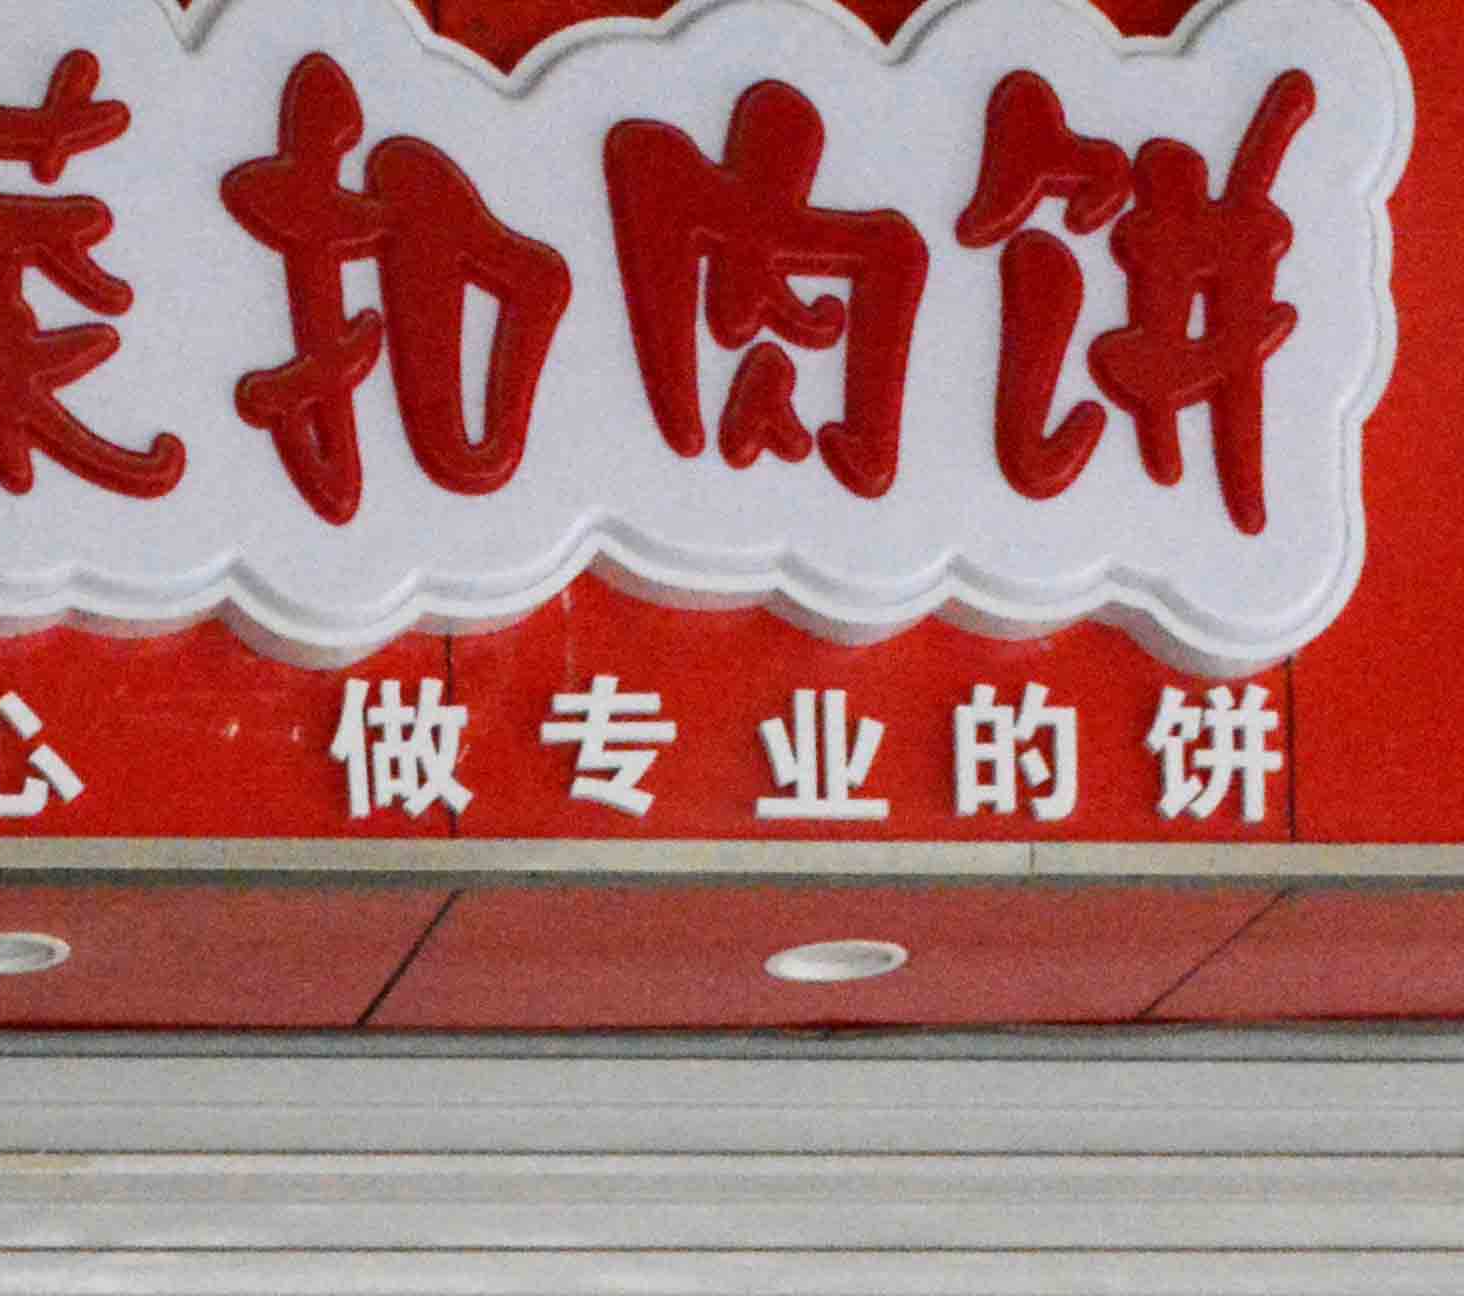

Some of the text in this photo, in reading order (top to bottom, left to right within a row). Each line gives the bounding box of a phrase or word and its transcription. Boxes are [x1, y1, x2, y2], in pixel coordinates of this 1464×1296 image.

[330, 676, 1285, 822] 做专业的饼
